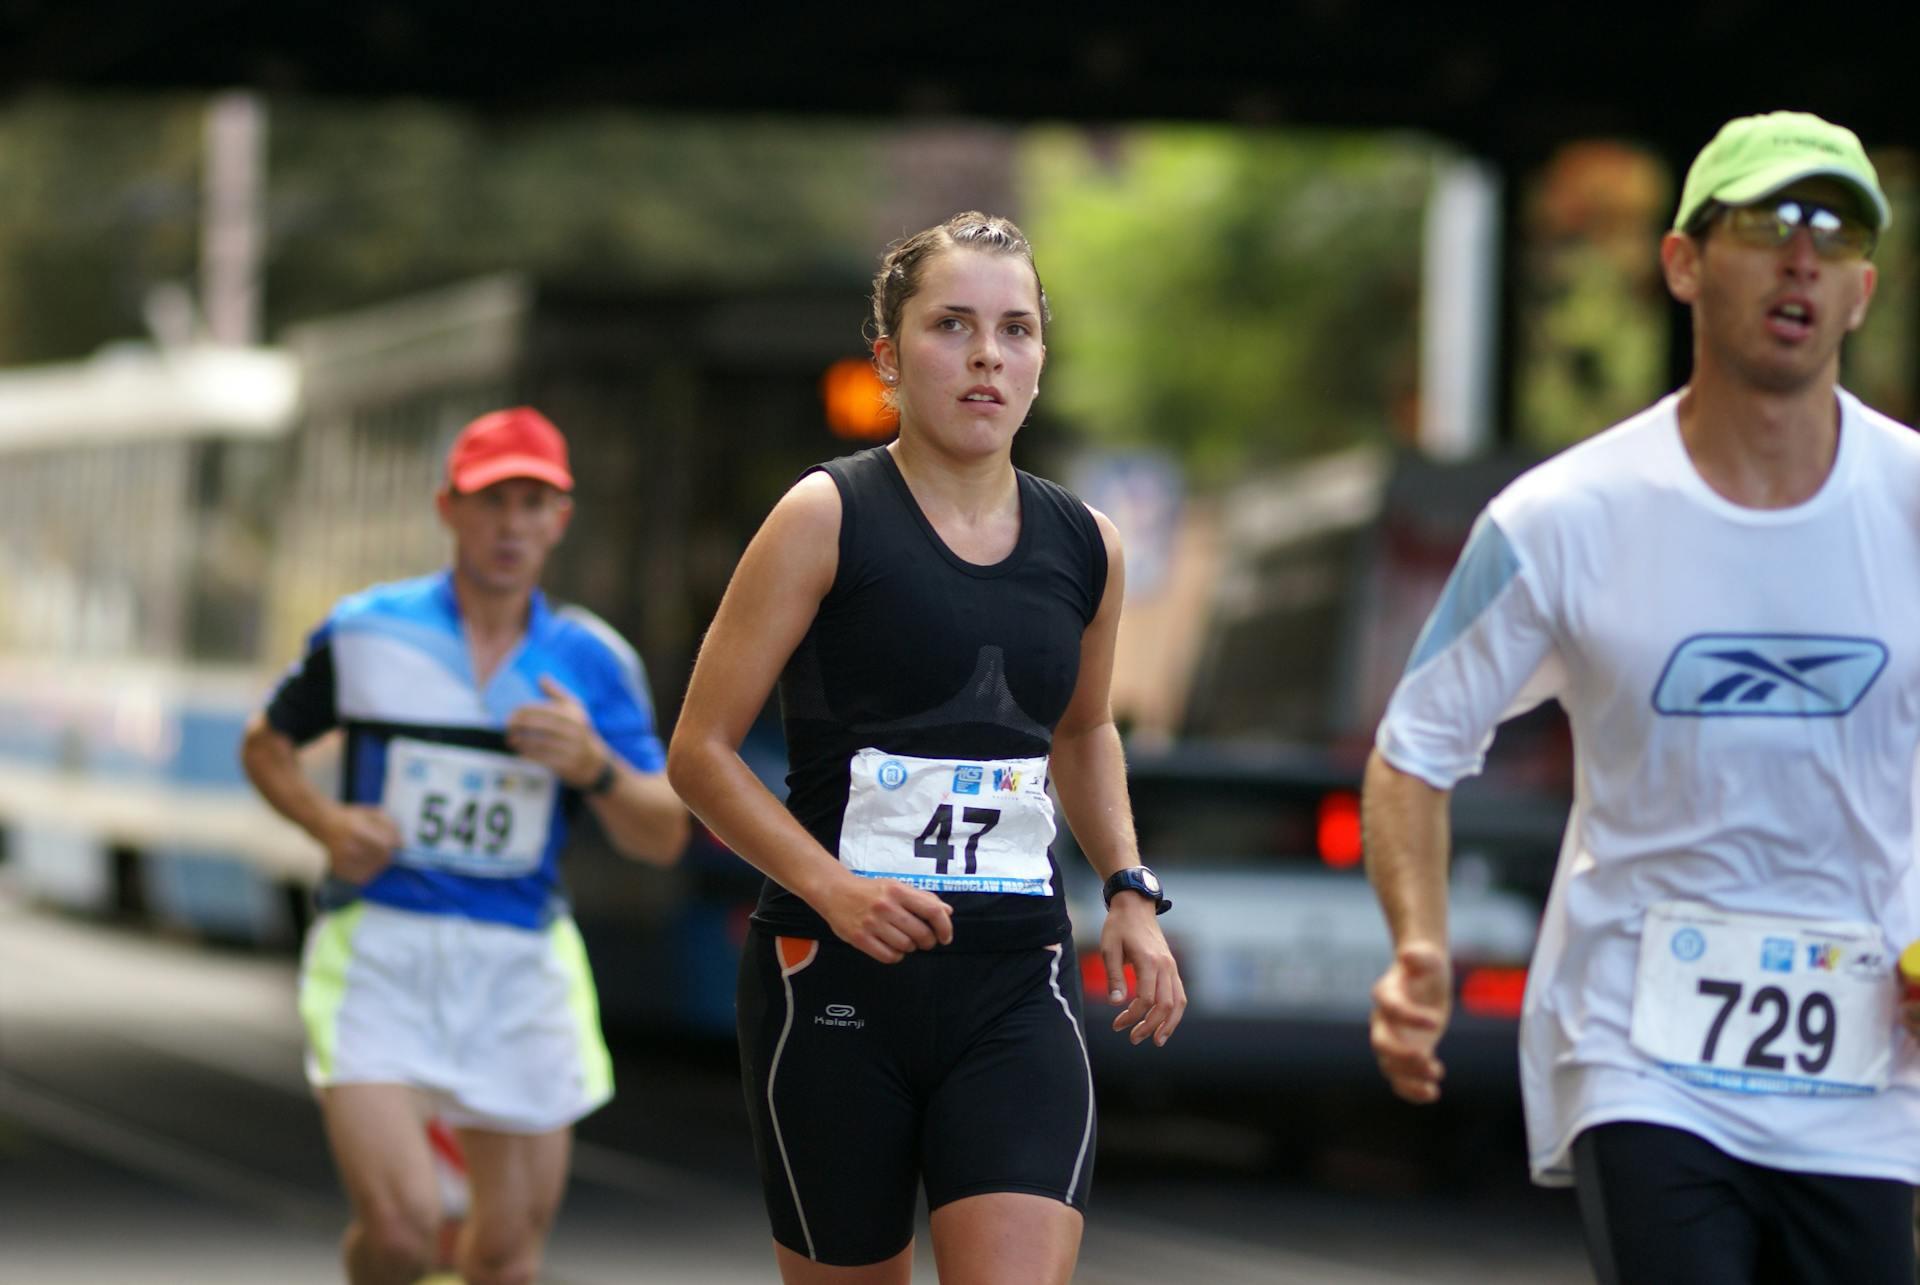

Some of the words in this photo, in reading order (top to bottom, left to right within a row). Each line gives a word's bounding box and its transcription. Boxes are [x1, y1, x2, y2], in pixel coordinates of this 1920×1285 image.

[417, 794, 513, 853] 549
[914, 804, 1001, 875] 47
[814, 1015, 865, 1029] Kalenji
[1697, 978, 1837, 1075] 729
